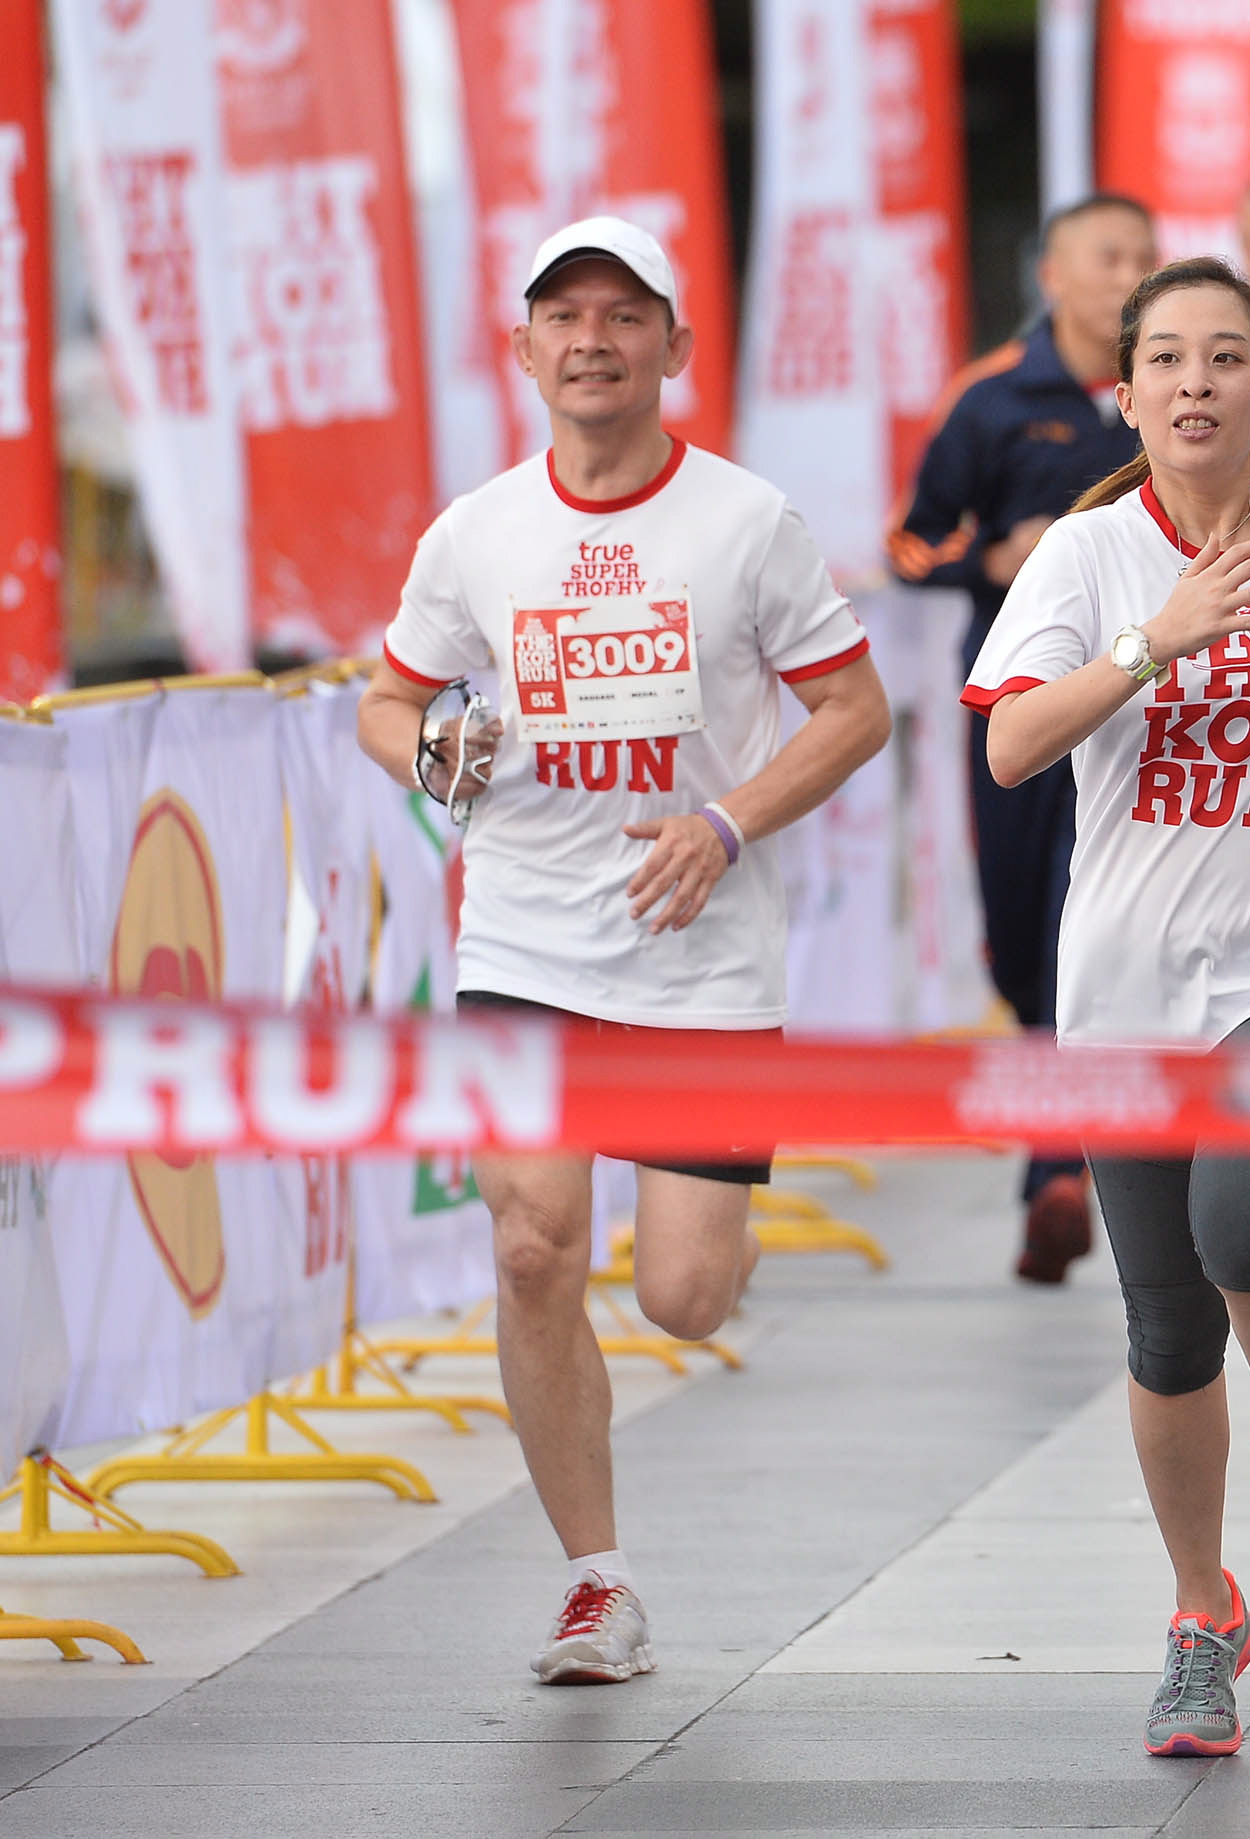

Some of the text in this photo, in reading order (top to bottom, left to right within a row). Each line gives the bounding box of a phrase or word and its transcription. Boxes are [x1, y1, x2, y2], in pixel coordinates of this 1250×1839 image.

[579, 541, 635, 561] true
[570, 563, 639, 580] SUPER
[515, 633, 556, 652] THE
[567, 630, 686, 678] 3009
[519, 665, 559, 684] RUN
[535, 735, 680, 793] RUN
[76, 1000, 561, 1145] RUN
